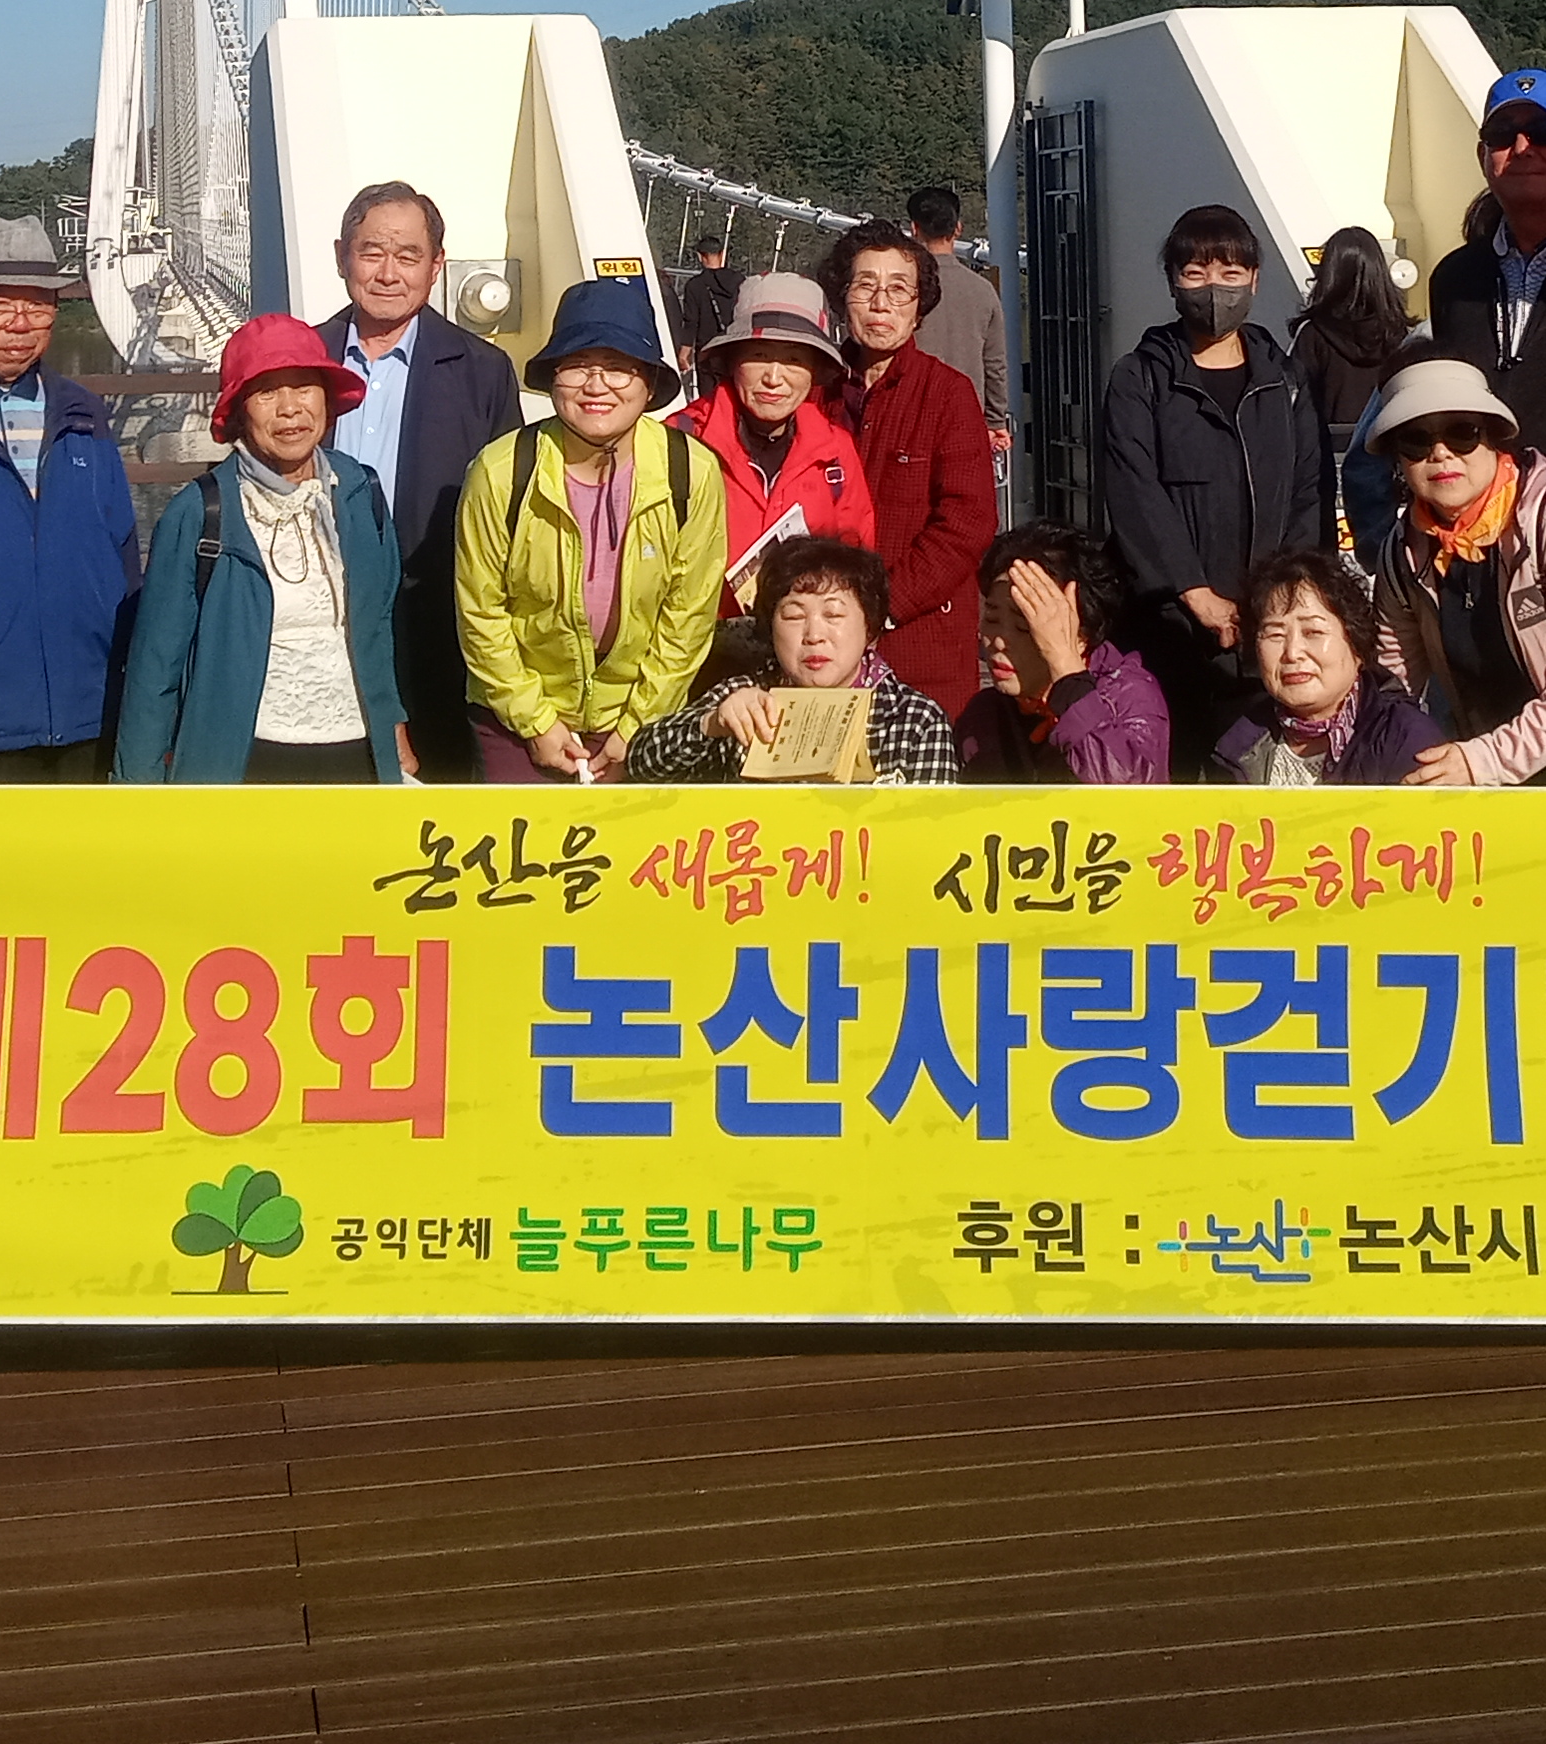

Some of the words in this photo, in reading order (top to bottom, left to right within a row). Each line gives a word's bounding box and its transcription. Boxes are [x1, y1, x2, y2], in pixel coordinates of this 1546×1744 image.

[601, 261, 638, 273] 위험
[372, 817, 612, 916] 논산을
[629, 819, 871, 925] 새롭게!
[933, 819, 1132, 915] 시민을
[1146, 817, 1485, 925] 행복하게!
[330, 1217, 492, 1262] 공익단체
[509, 1206, 823, 1273] 늘푸른나무
[952, 1200, 1087, 1274] 후원
[1185, 1198, 1312, 1282] 논산
[1338, 1202, 1541, 1276] 논산시
